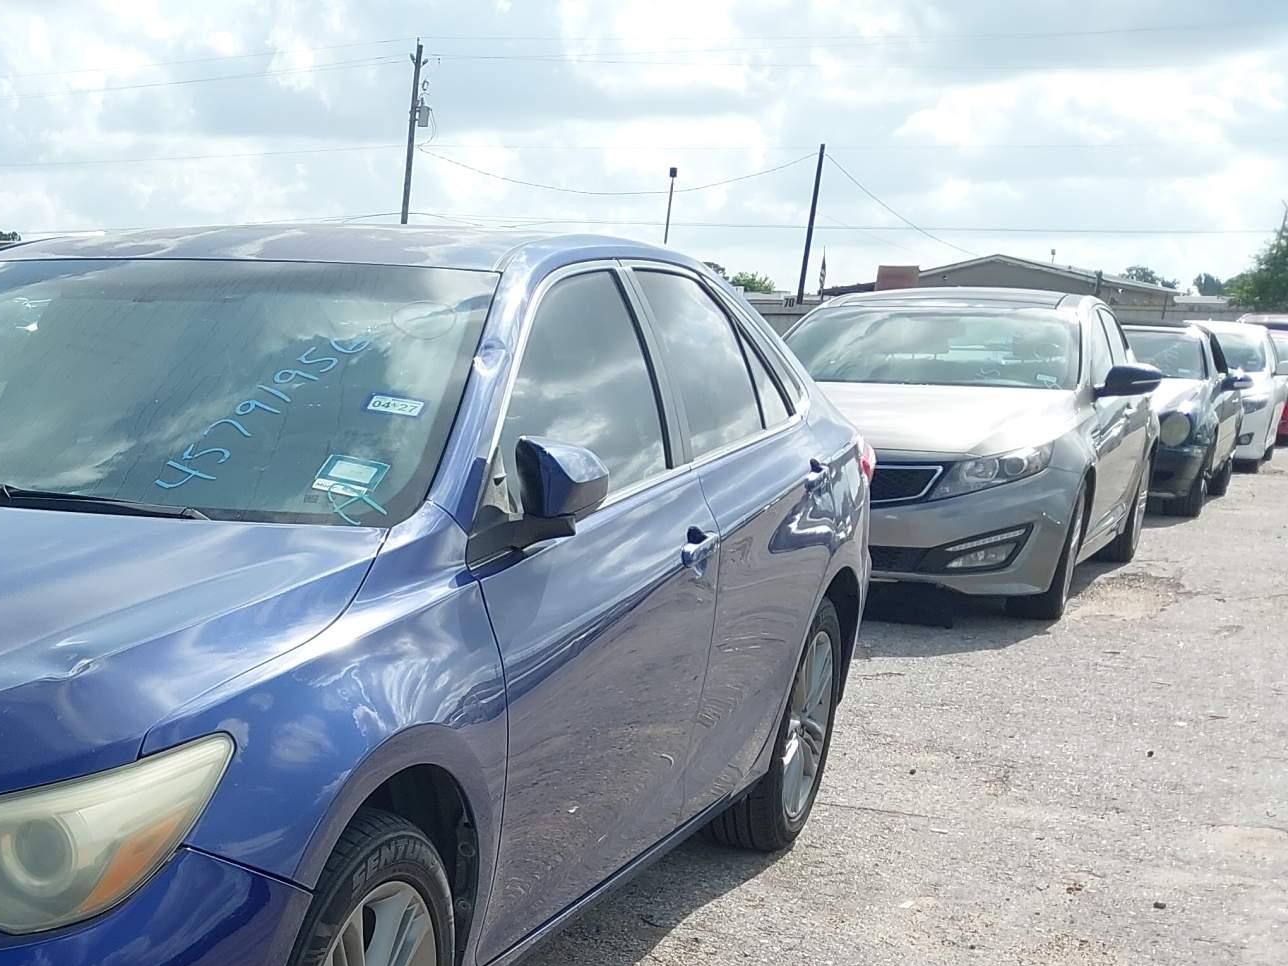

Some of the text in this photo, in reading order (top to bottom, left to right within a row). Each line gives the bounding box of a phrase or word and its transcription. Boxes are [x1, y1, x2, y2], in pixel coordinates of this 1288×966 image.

[783, 297, 795, 307] 70
[372, 400, 418, 413] 04 27
